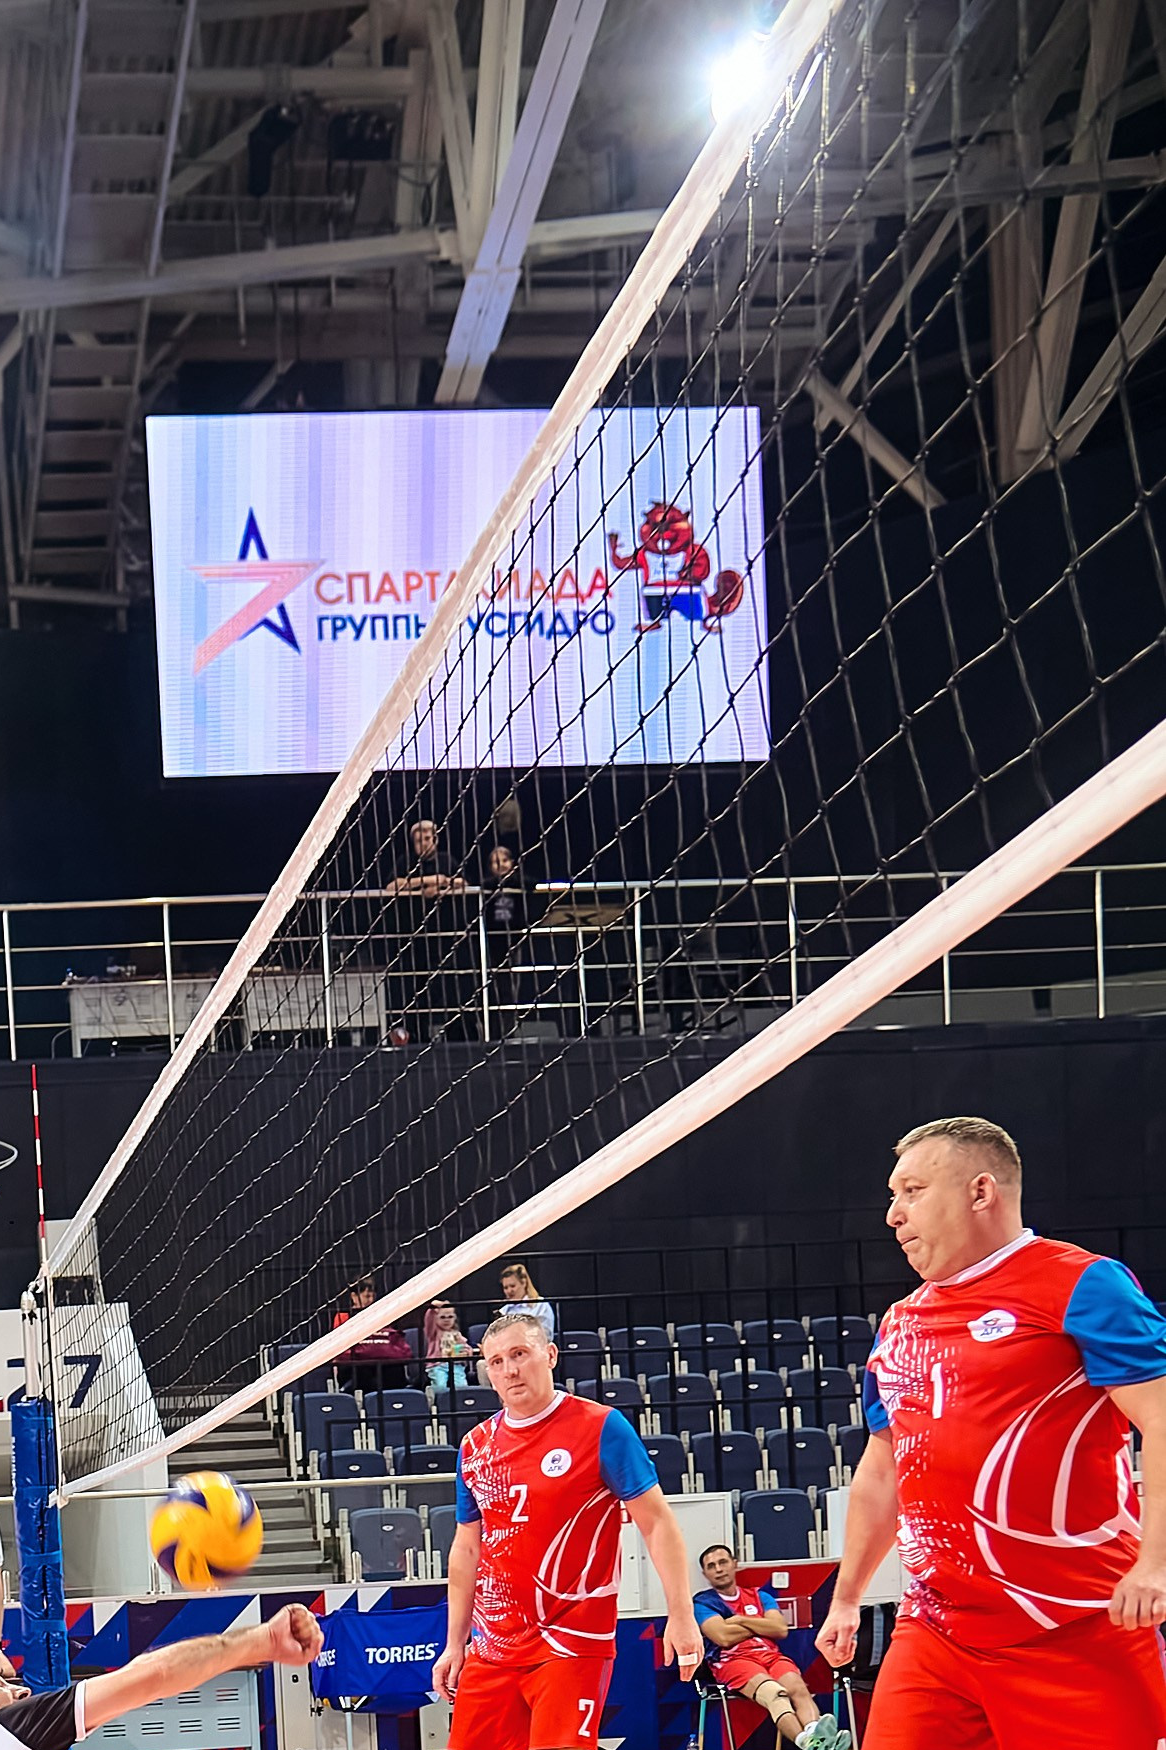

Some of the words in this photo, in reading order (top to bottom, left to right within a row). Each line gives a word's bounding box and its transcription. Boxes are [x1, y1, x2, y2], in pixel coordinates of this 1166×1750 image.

[314, 568, 612, 604] СПАРТИАДА
[466, 609, 615, 640] УСГИДРО
[930, 1362, 943, 1419] 1
[508, 1484, 529, 1523] 2
[365, 1643, 436, 1664] TORRES
[577, 1698, 595, 1737] 2
